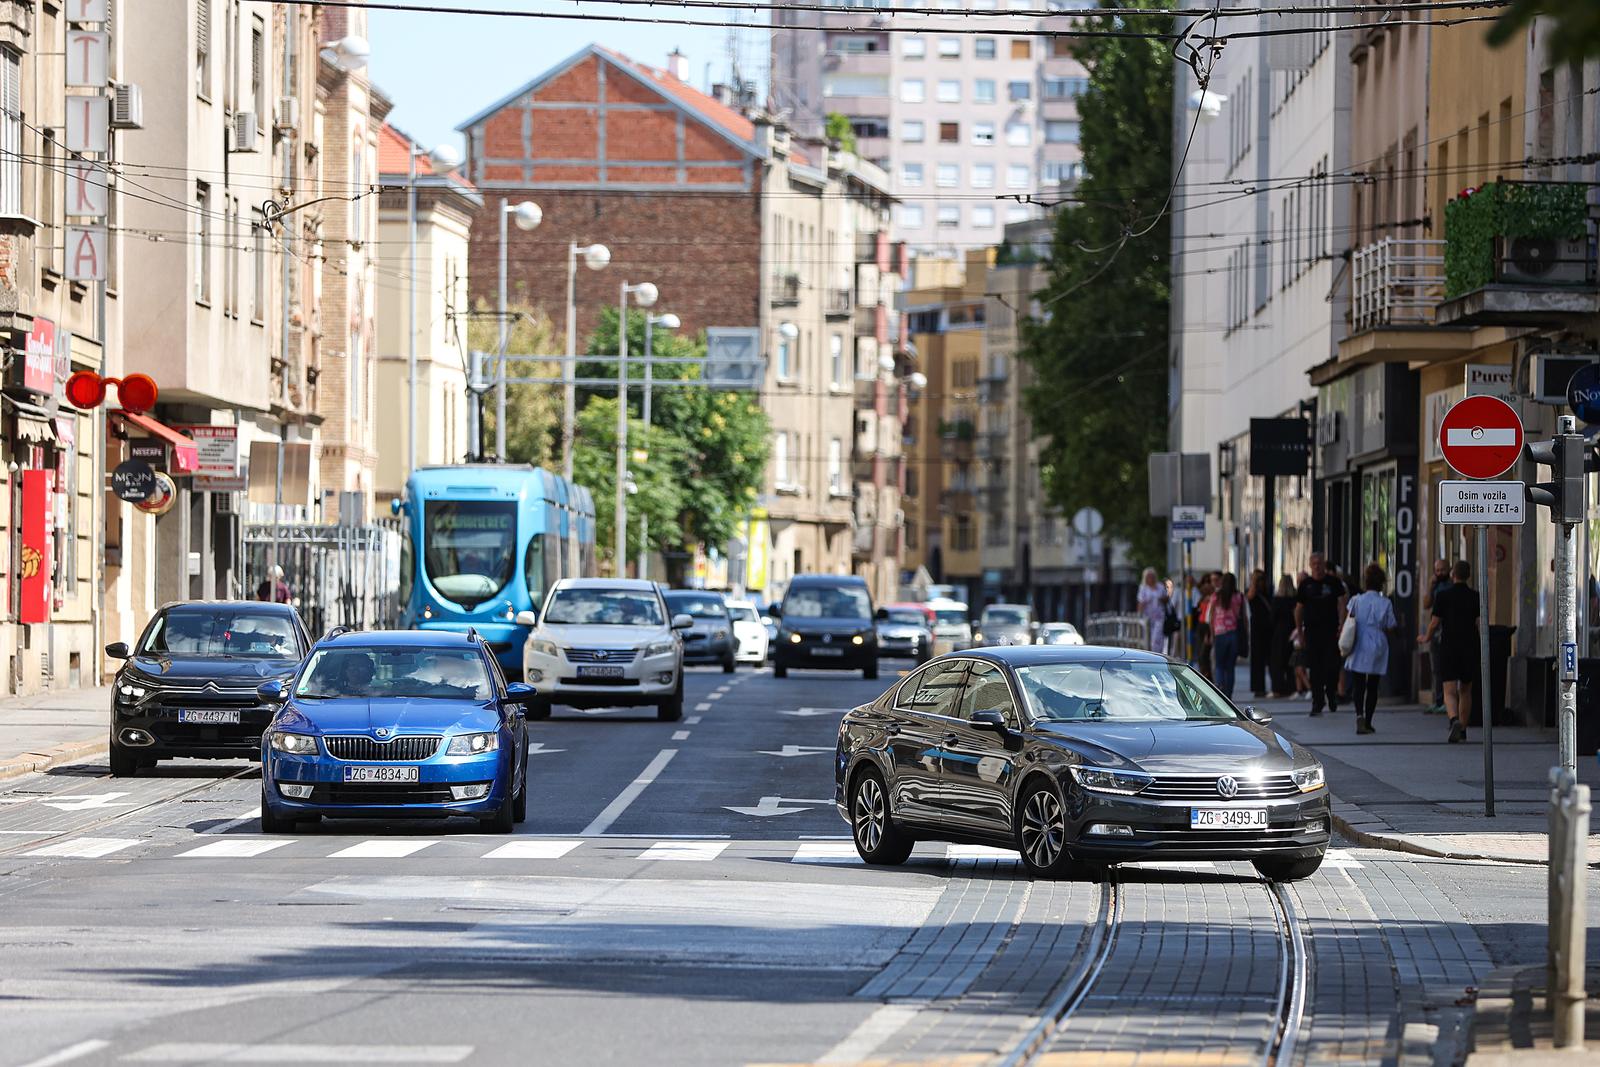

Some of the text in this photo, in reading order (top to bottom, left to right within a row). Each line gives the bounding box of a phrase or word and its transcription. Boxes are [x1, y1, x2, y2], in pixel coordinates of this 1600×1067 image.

[215, 428, 235, 437] HAIR
[1458, 490, 1507, 500] Osim vozila
[1445, 503, 1485, 515] gradilišta
[1493, 503, 1519, 513] ZET-a
[1396, 475, 1413, 598] FOTO
[185, 710, 197, 721] ZG
[352, 768, 366, 780] ZG
[1199, 811, 1214, 824] ZG
